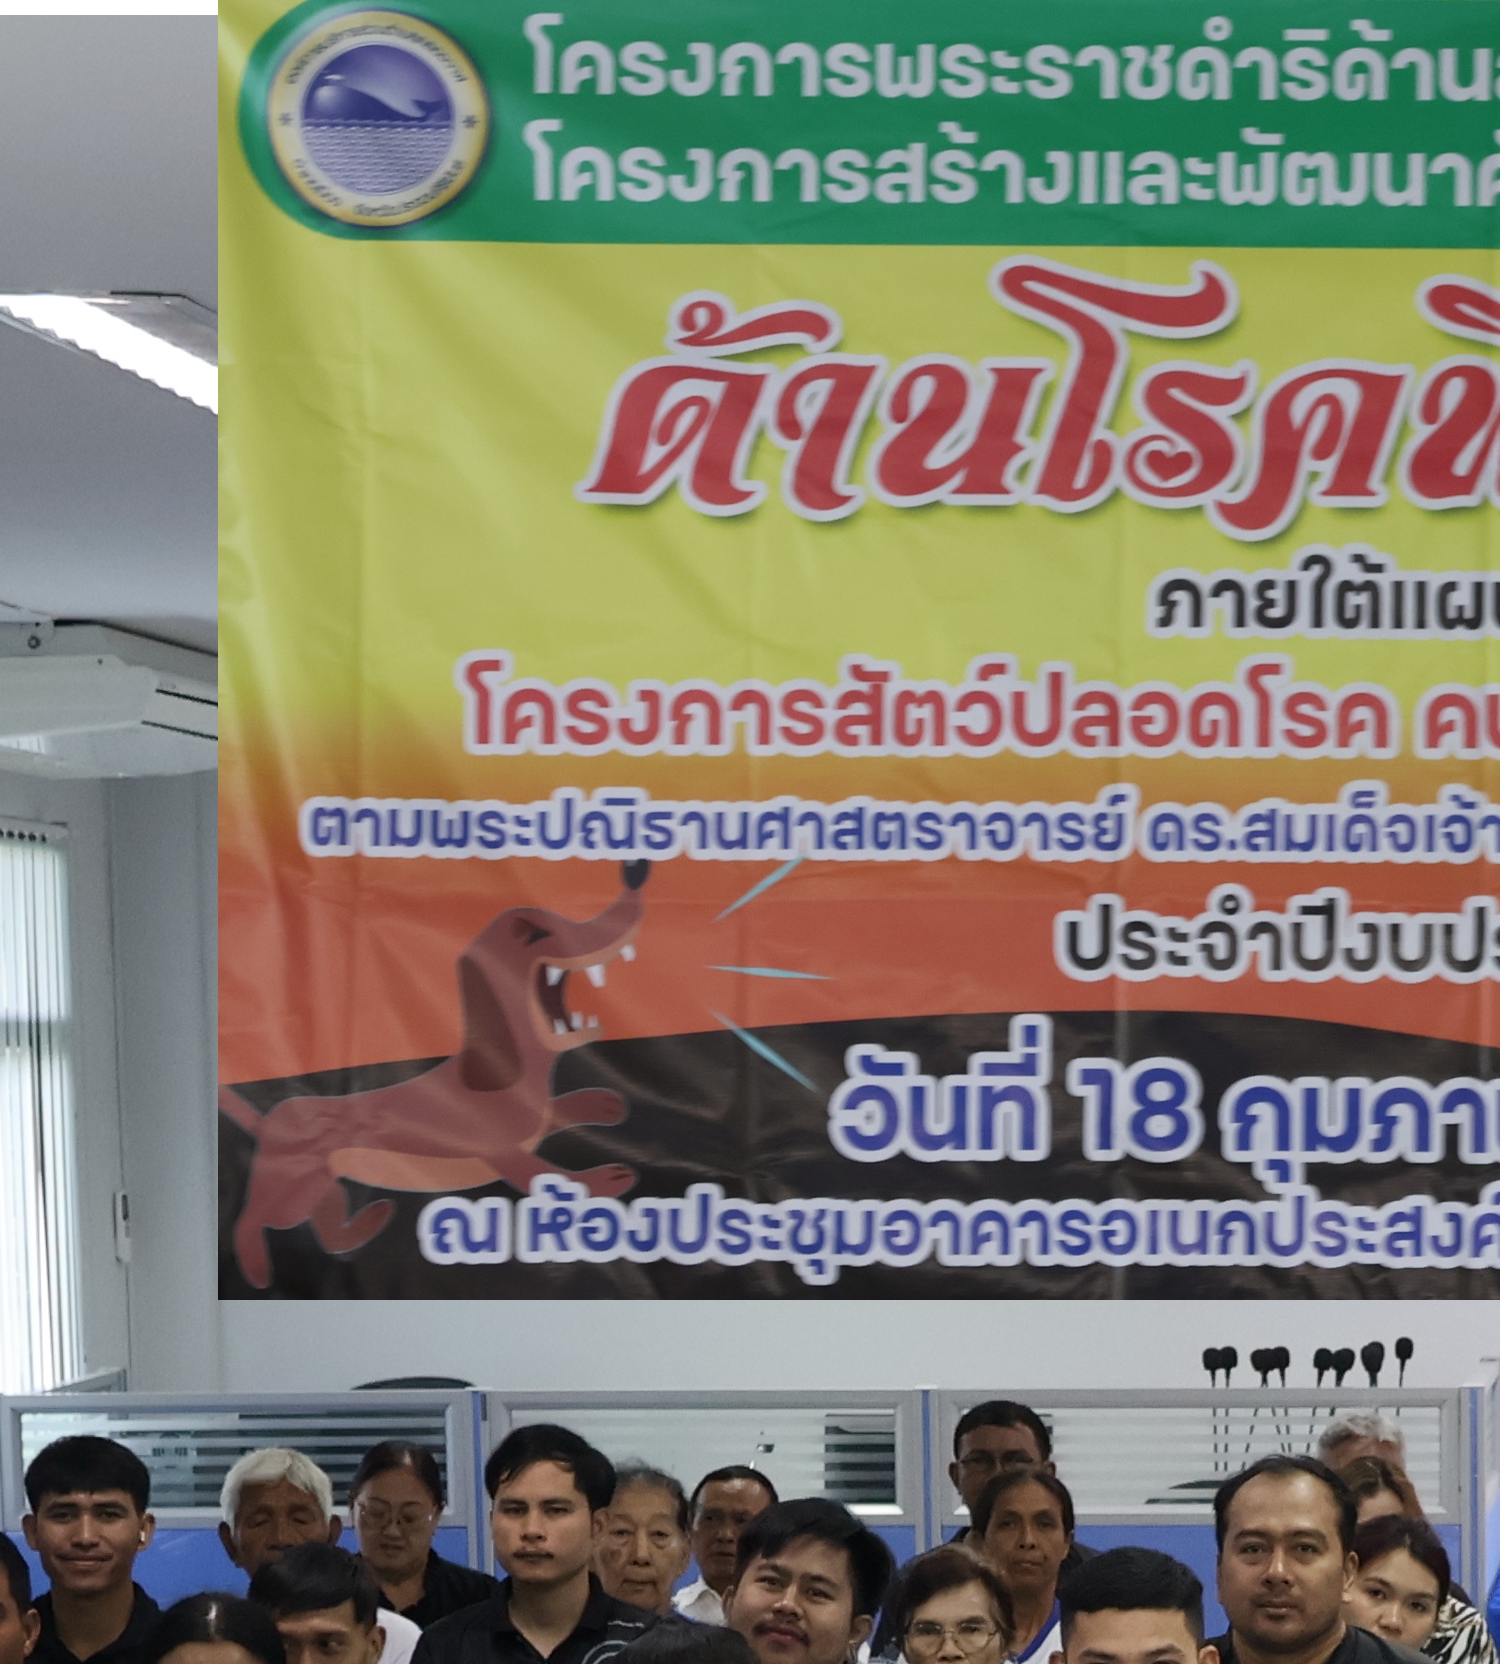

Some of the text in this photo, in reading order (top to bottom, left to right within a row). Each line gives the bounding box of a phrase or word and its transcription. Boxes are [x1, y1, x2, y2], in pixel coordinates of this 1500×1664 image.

[462, 660, 1390, 754] โครงการสัตว์ปลอดโรค
[308, 795, 1128, 852] ตามพระปณิธานศาสตราจารย์
[840, 1018, 1044, 1156] วันที่
[1080, 1066, 1194, 1158] 18
